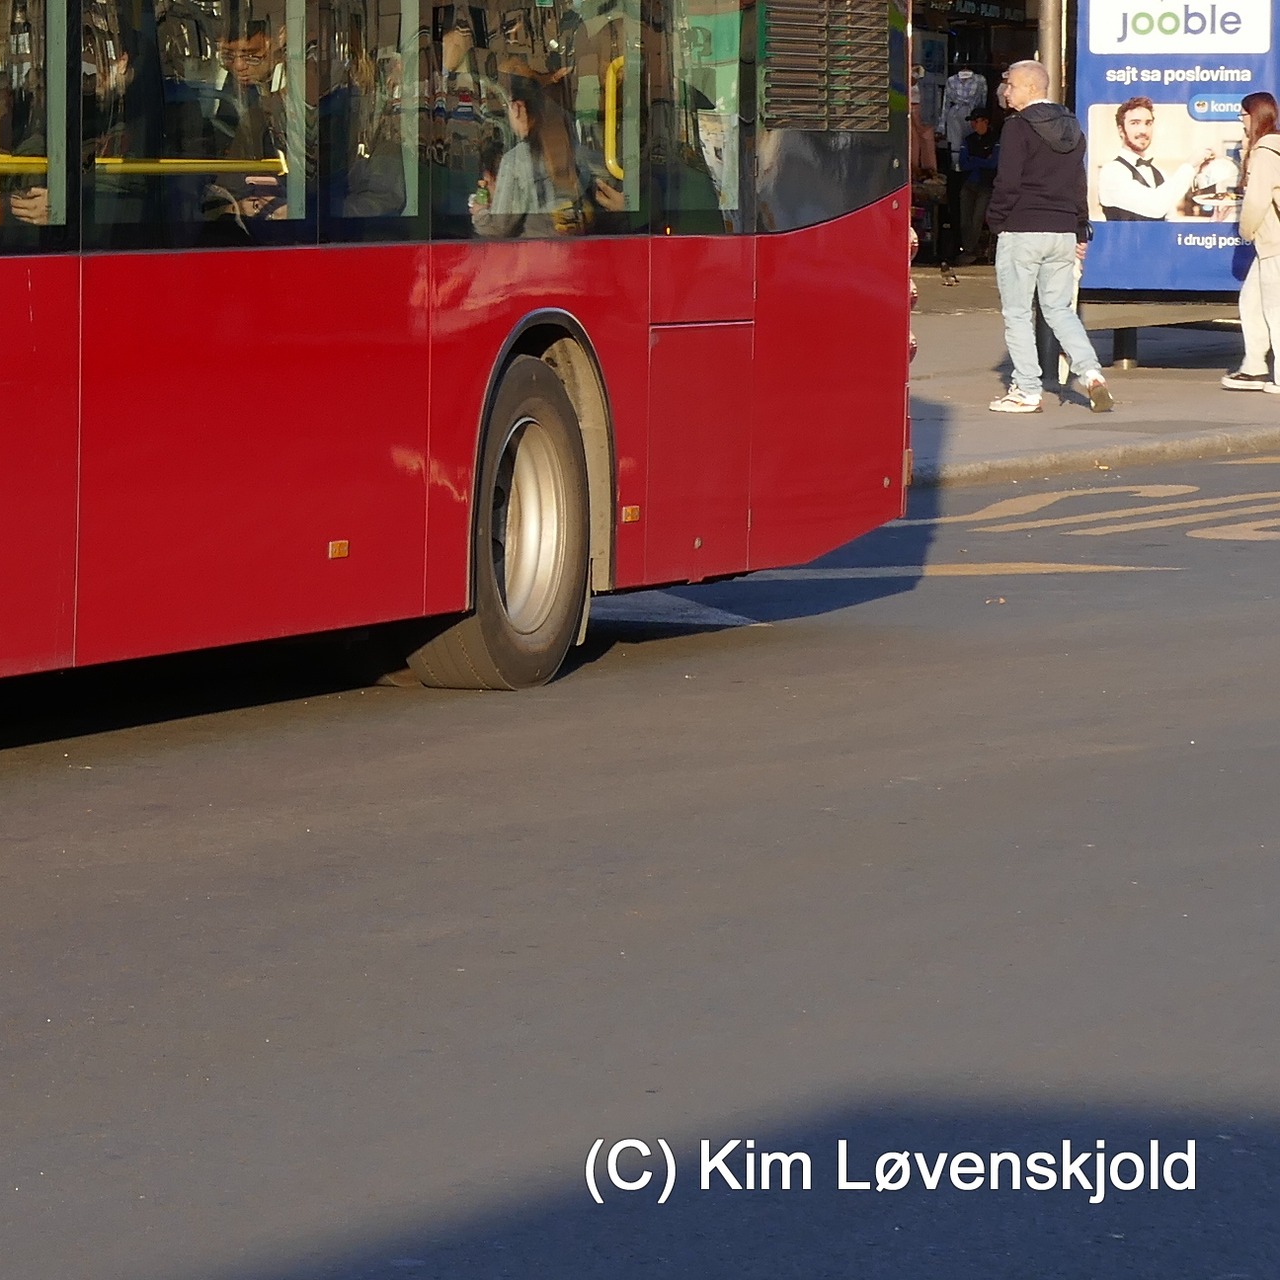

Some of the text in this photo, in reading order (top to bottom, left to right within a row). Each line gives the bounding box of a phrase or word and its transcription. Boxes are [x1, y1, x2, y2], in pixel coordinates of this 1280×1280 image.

[1116, 4, 1243, 43] jooble
[1105, 65, 1252, 86] sajt sa poslovima
[1177, 233, 1183, 246] i
[1183, 233, 1218, 249] drugi
